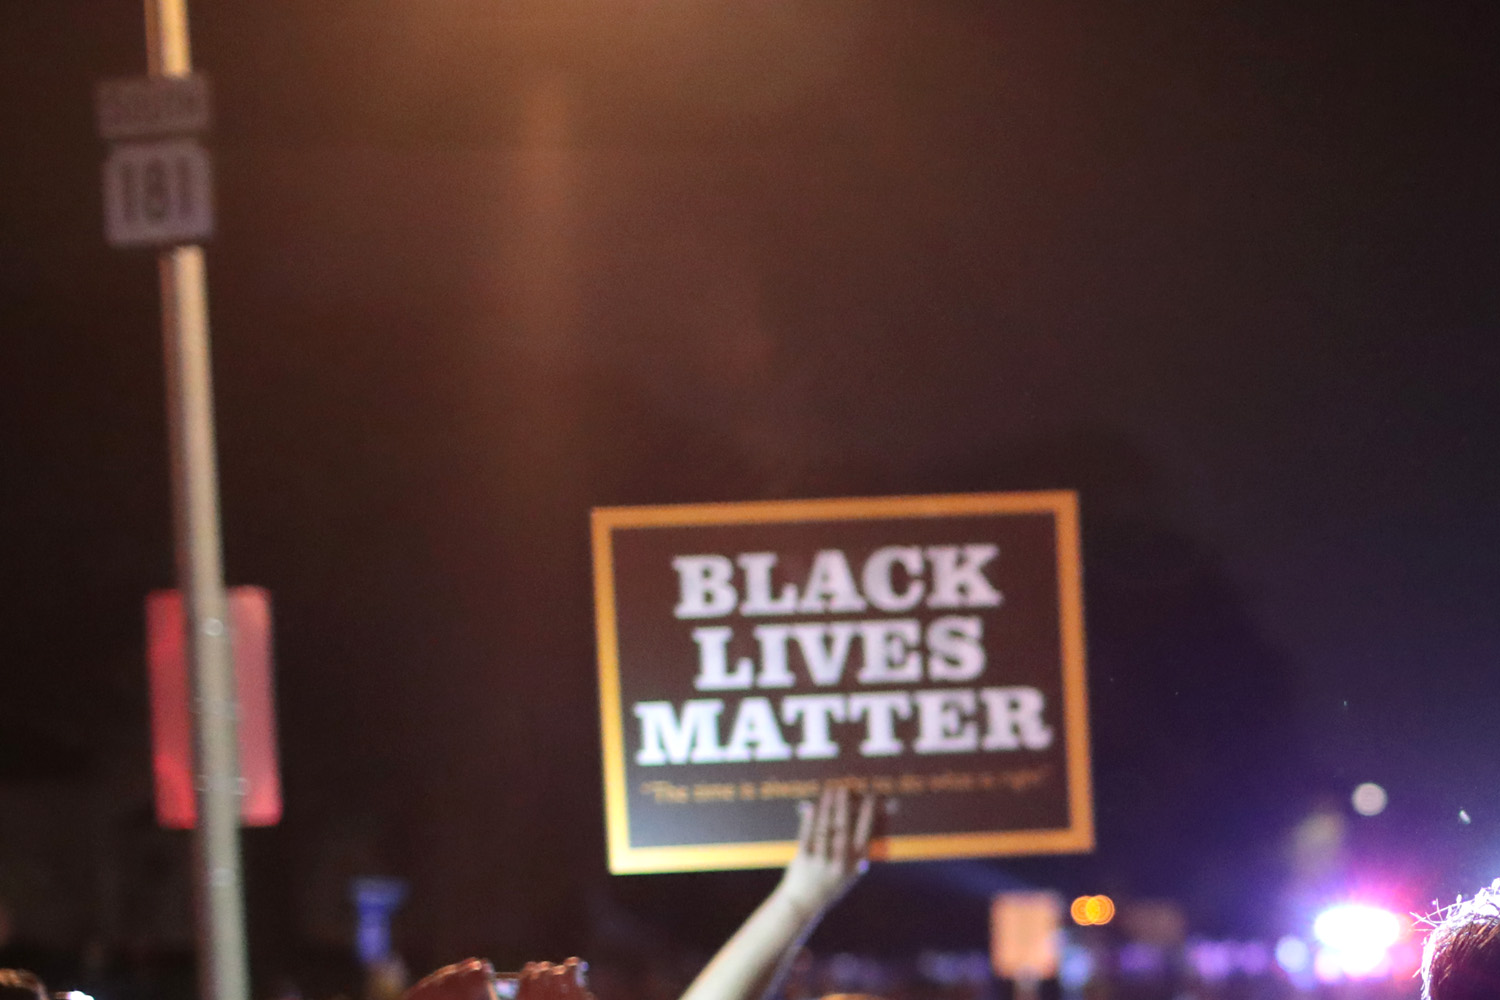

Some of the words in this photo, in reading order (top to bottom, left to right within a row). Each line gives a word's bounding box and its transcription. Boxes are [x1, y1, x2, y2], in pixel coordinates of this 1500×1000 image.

[120, 156, 195, 223] 181
[671, 544, 1004, 619] BLACK
[692, 615, 986, 691] LIVES
[634, 686, 1054, 766] MATTER
